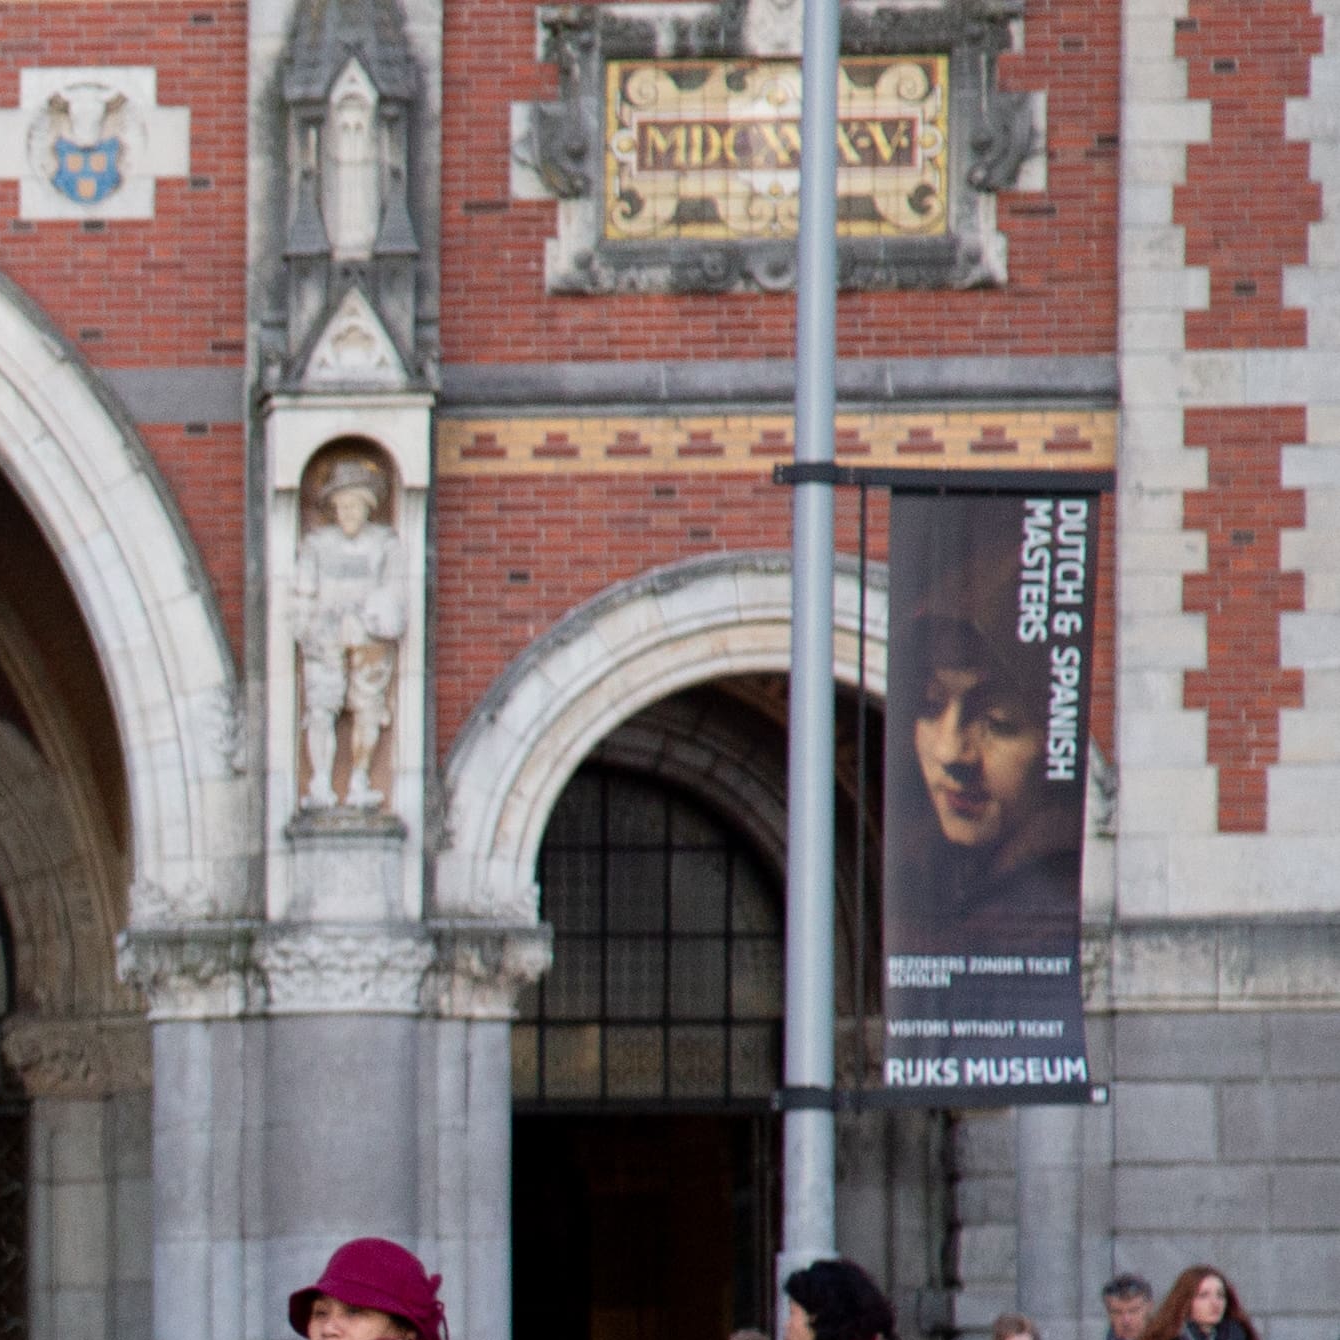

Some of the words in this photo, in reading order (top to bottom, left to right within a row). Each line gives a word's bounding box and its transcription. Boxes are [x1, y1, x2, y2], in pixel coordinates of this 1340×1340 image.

[1054, 498, 1088, 604] DUTCH
[1018, 498, 1053, 642] MASTERS
[1052, 610, 1083, 637] &
[1046, 645, 1082, 780] SPANISH
[1027, 956, 1072, 974] TICKET
[887, 1019, 950, 1037] VISITORS
[953, 1019, 1016, 1037] WITHOUT
[1019, 1019, 1065, 1037] TICKET
[965, 1056, 1088, 1085] MUSEUM
